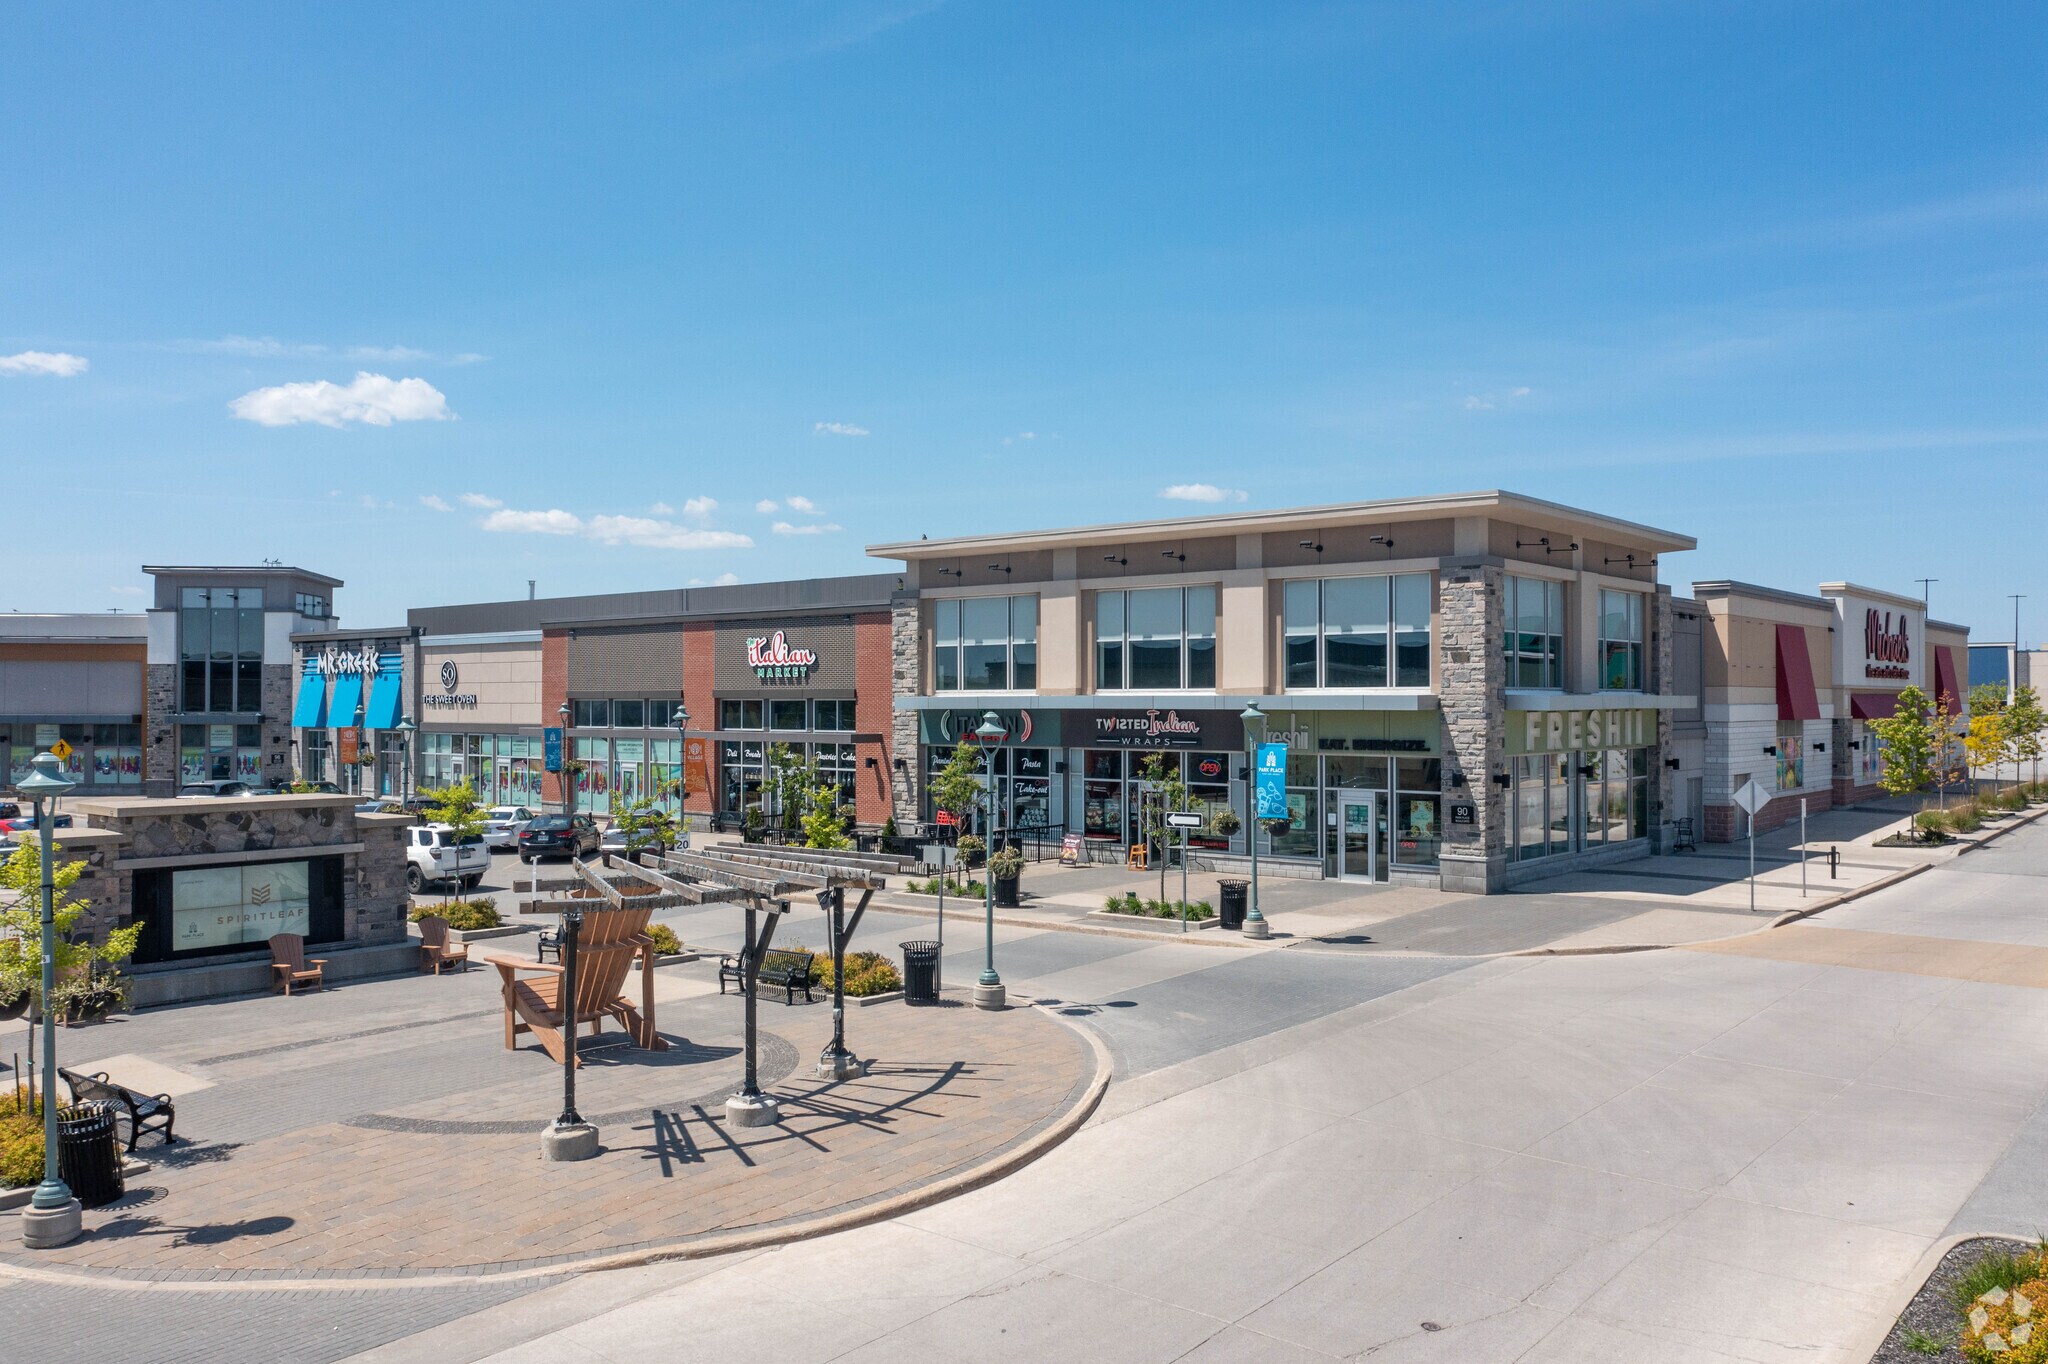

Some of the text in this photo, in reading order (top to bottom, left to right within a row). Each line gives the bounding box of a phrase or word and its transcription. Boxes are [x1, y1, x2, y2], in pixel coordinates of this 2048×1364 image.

[1865, 608, 1909, 663] Michaels
[748, 631, 816, 666] italian
[758, 667, 807, 678] MARKET
[422, 695, 476, 704] THE SWEET OVEN
[955, 716, 1017, 732] ITAAN
[1096, 710, 1200, 736] TWISTED Indian
[1526, 710, 1643, 750] FRESHII
[1122, 737, 1170, 746] WRAPS
[726, 749, 738, 757] Deli
[1021, 758, 1041, 769] Pasta
[1200, 763, 1220, 773] OPEN
[1015, 782, 1048, 794] Take-out
[1457, 807, 1468, 816] 90
[677, 840, 689, 849] 20
[217, 908, 304, 925] SPIRITLEAF
